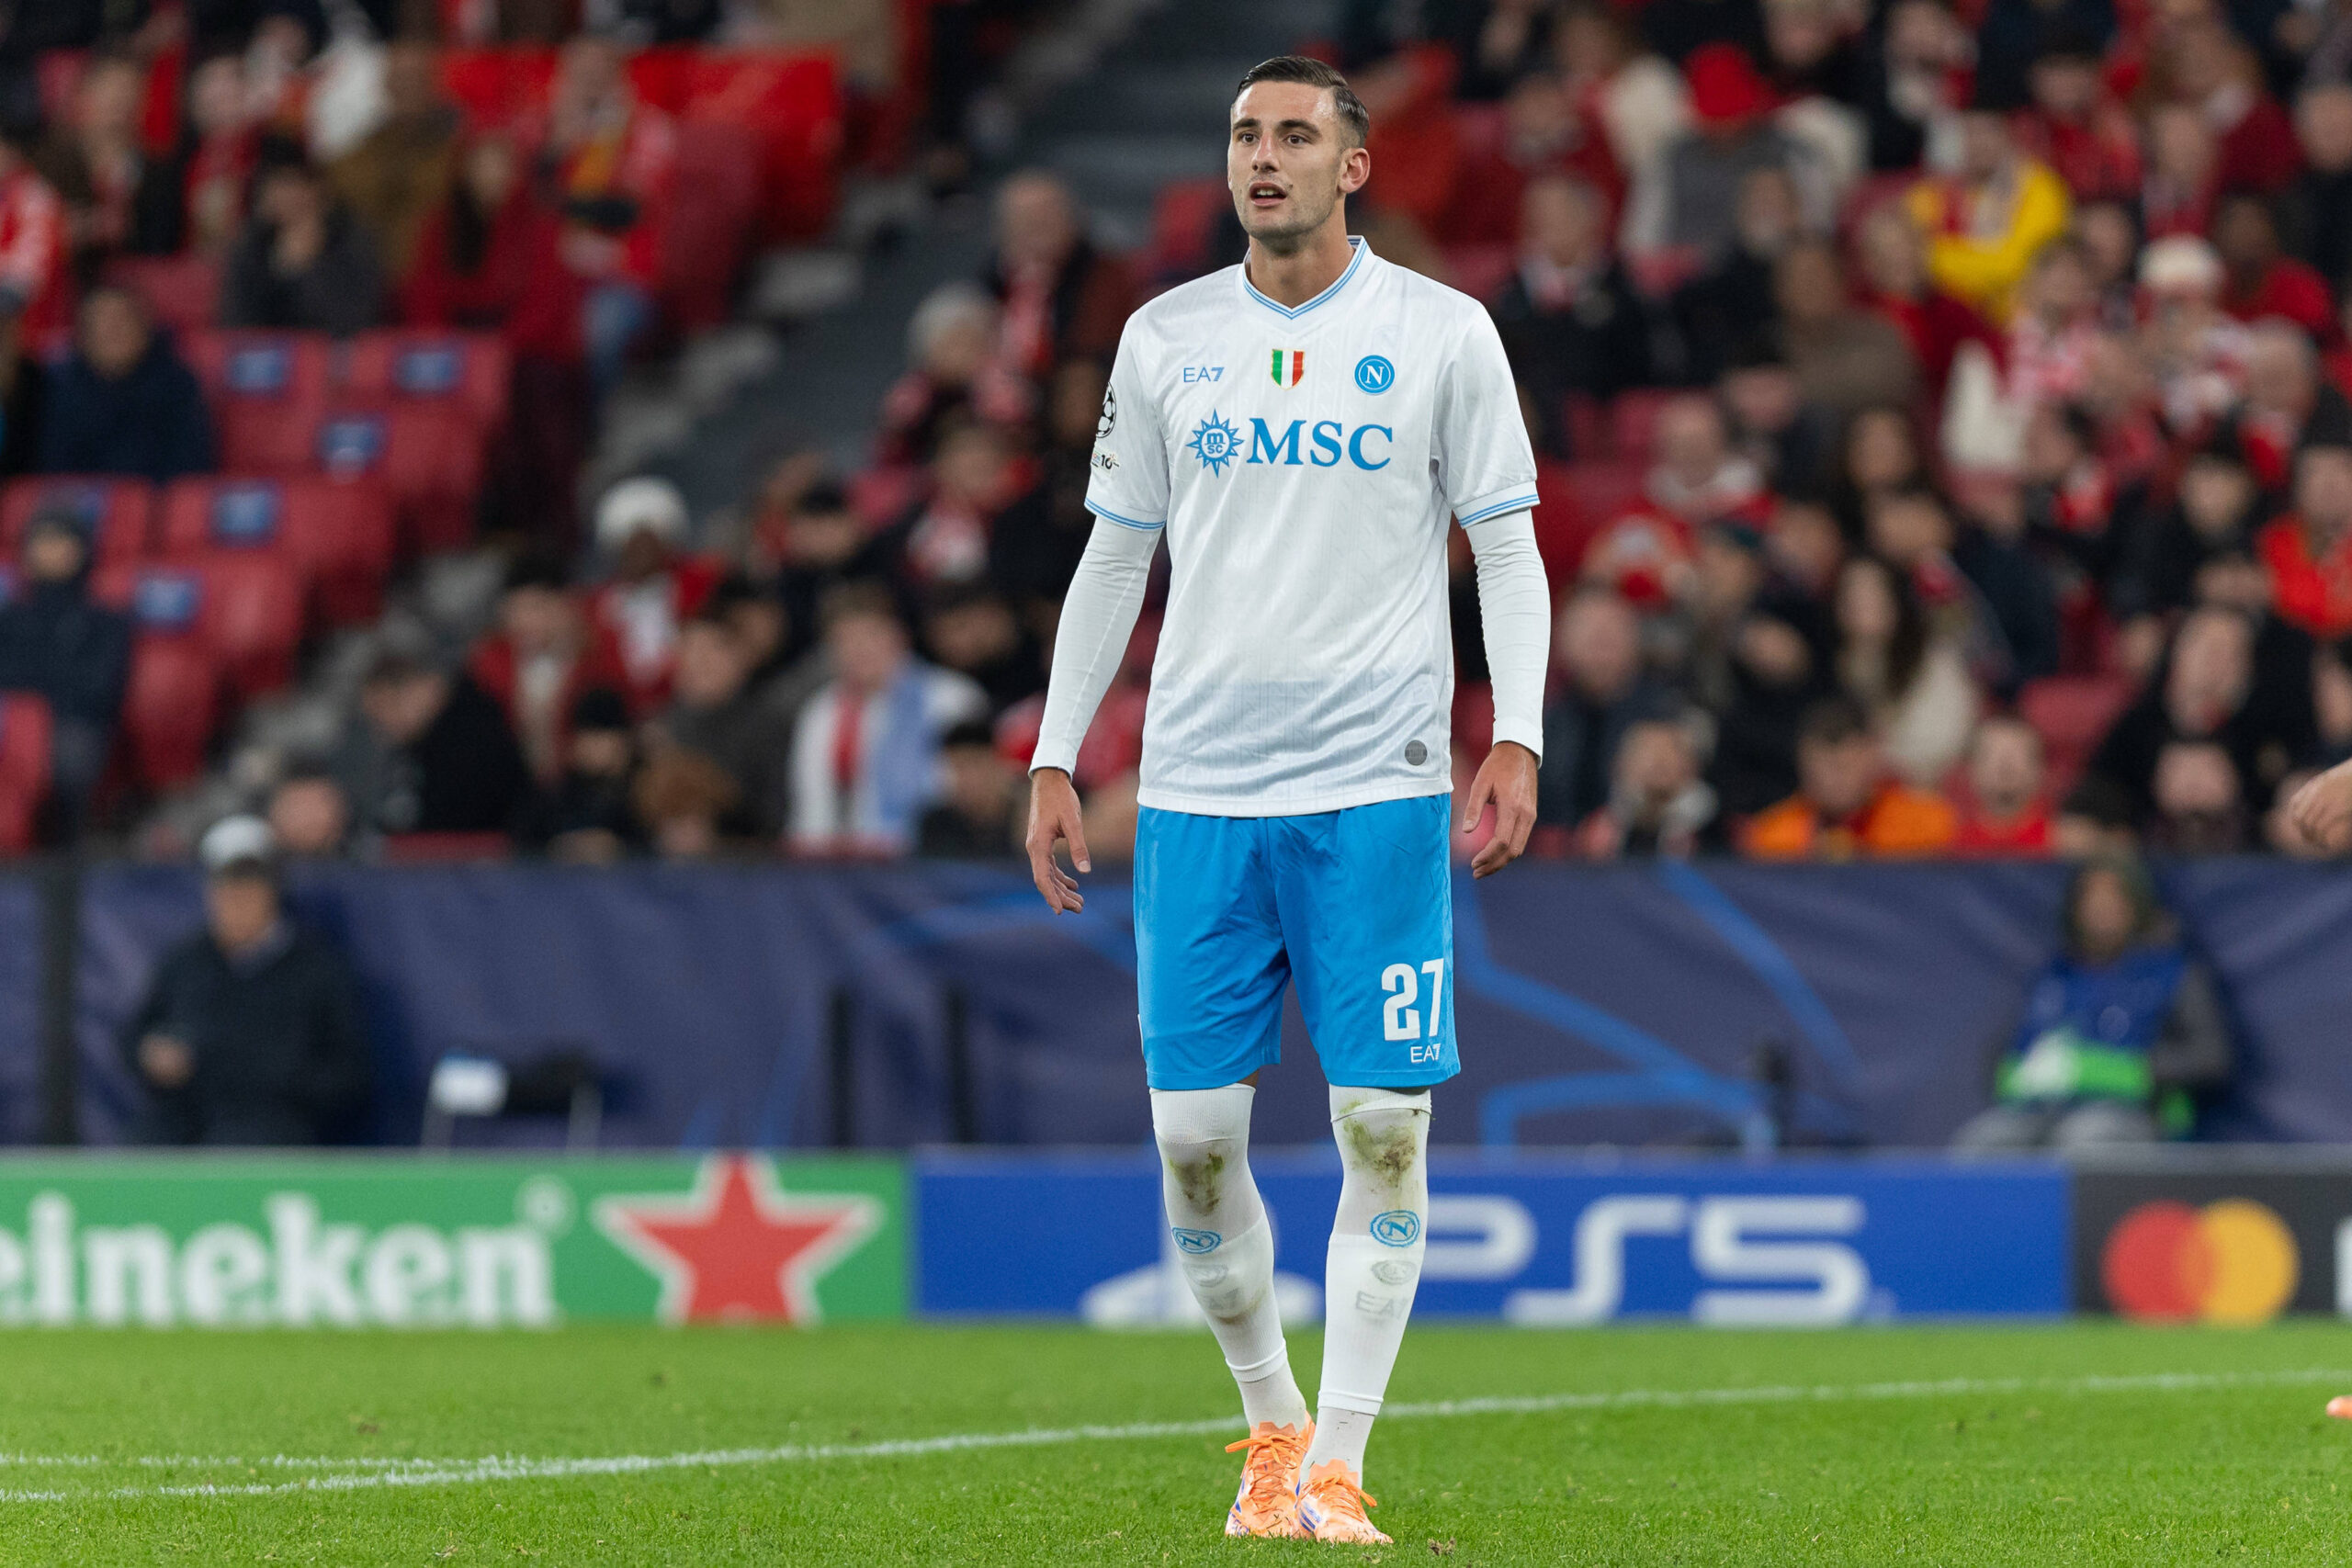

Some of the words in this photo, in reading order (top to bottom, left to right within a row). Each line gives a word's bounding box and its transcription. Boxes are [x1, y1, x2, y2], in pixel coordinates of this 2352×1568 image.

[1182, 366, 1225, 383] EA7
[1365, 365, 1385, 385] N
[1246, 417, 1394, 471] MSC
[1381, 957, 1445, 1042] 27
[1409, 1043, 1442, 1064] EA7
